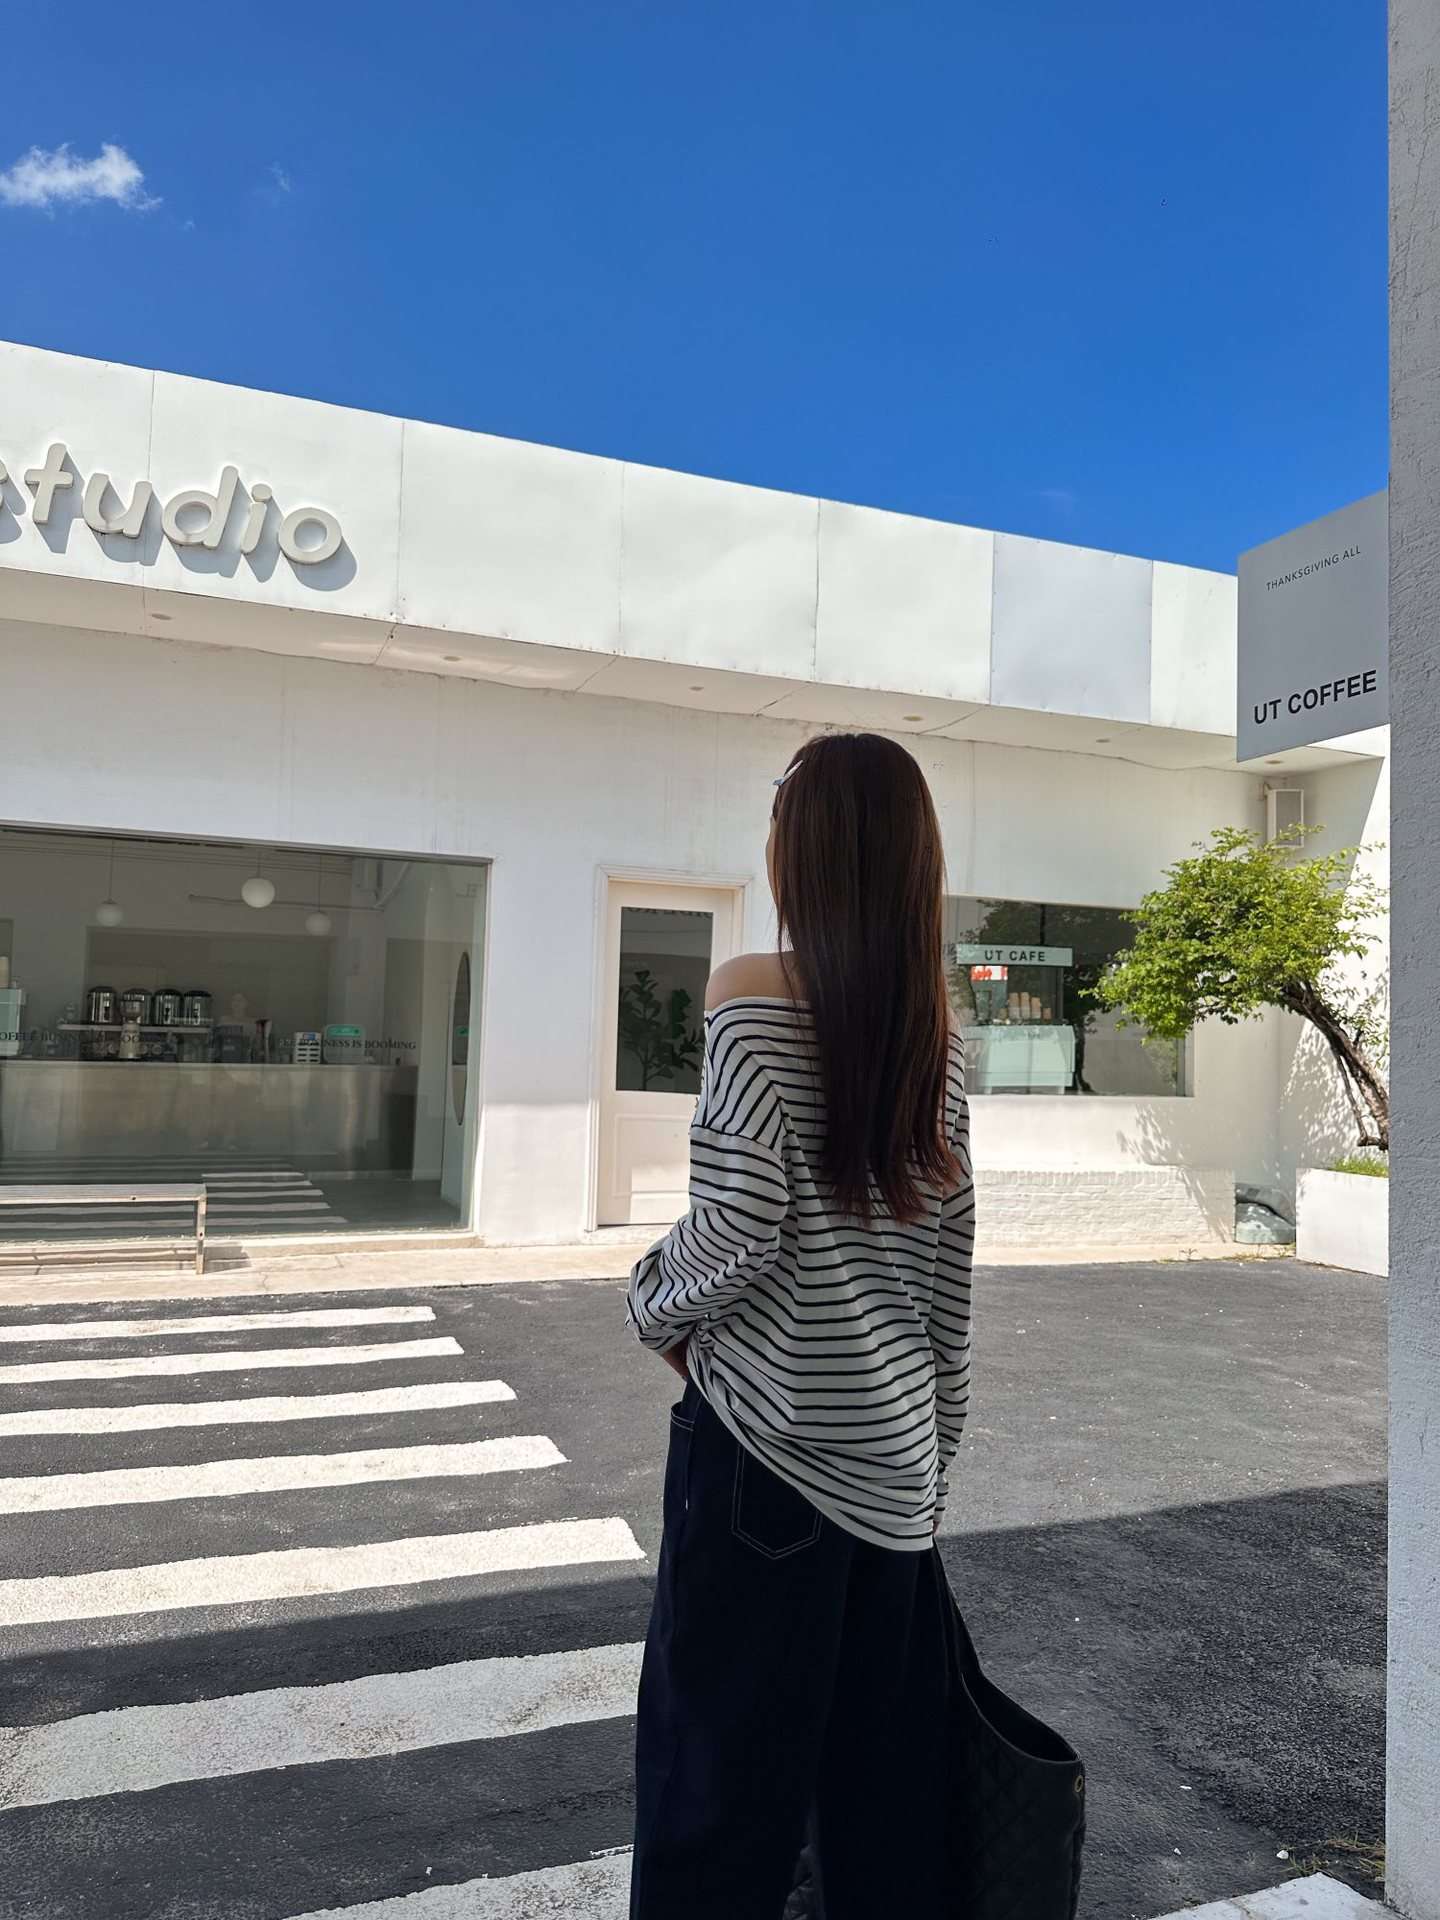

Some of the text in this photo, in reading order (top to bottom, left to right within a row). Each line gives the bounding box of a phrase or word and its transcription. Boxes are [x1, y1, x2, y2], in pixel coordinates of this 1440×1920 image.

[0, 443, 343, 564] tudio
[1265, 545, 1361, 591] THANKSGIVING ALL
[1253, 669, 1377, 725] UT COFFEE
[984, 950, 1046, 962] UT CAFE
